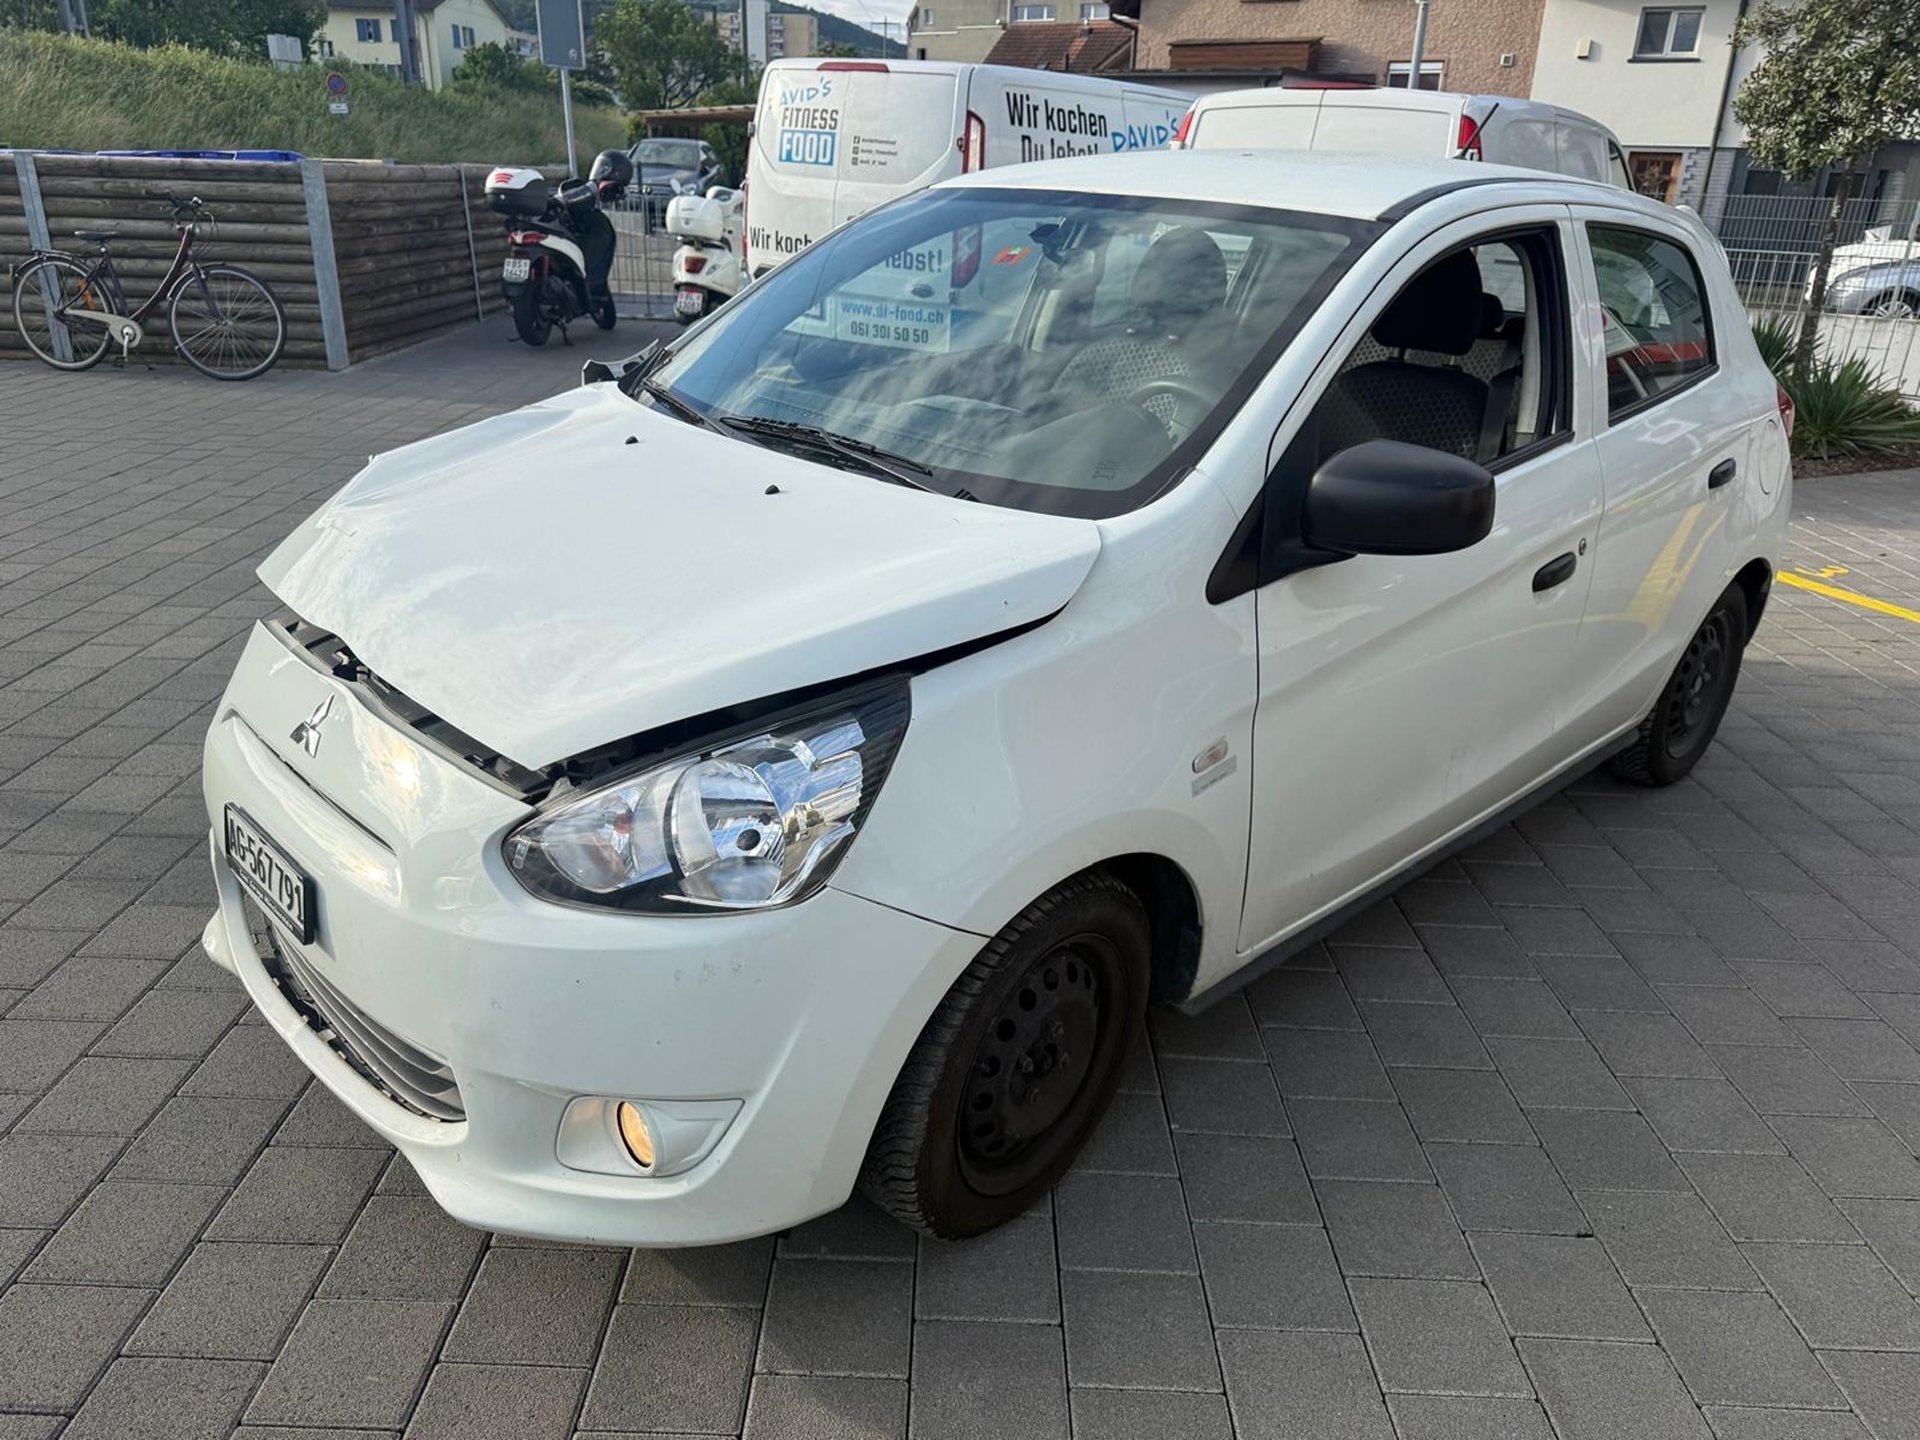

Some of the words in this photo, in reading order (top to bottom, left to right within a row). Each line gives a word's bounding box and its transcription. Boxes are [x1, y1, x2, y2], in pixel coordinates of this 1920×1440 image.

[779, 76, 833, 106] AVID'S
[781, 107, 839, 130] FITNESS
[1005, 91, 1040, 130] Wir
[1044, 98, 1109, 138] kochen
[1111, 110, 1179, 152] DAVID'S
[780, 131, 834, 165] FOOD
[750, 225, 771, 250] Wir
[850, 320, 869, 337] 061
[872, 324, 891, 340] 301
[893, 327, 910, 343] 50
[912, 329, 929, 344] 50
